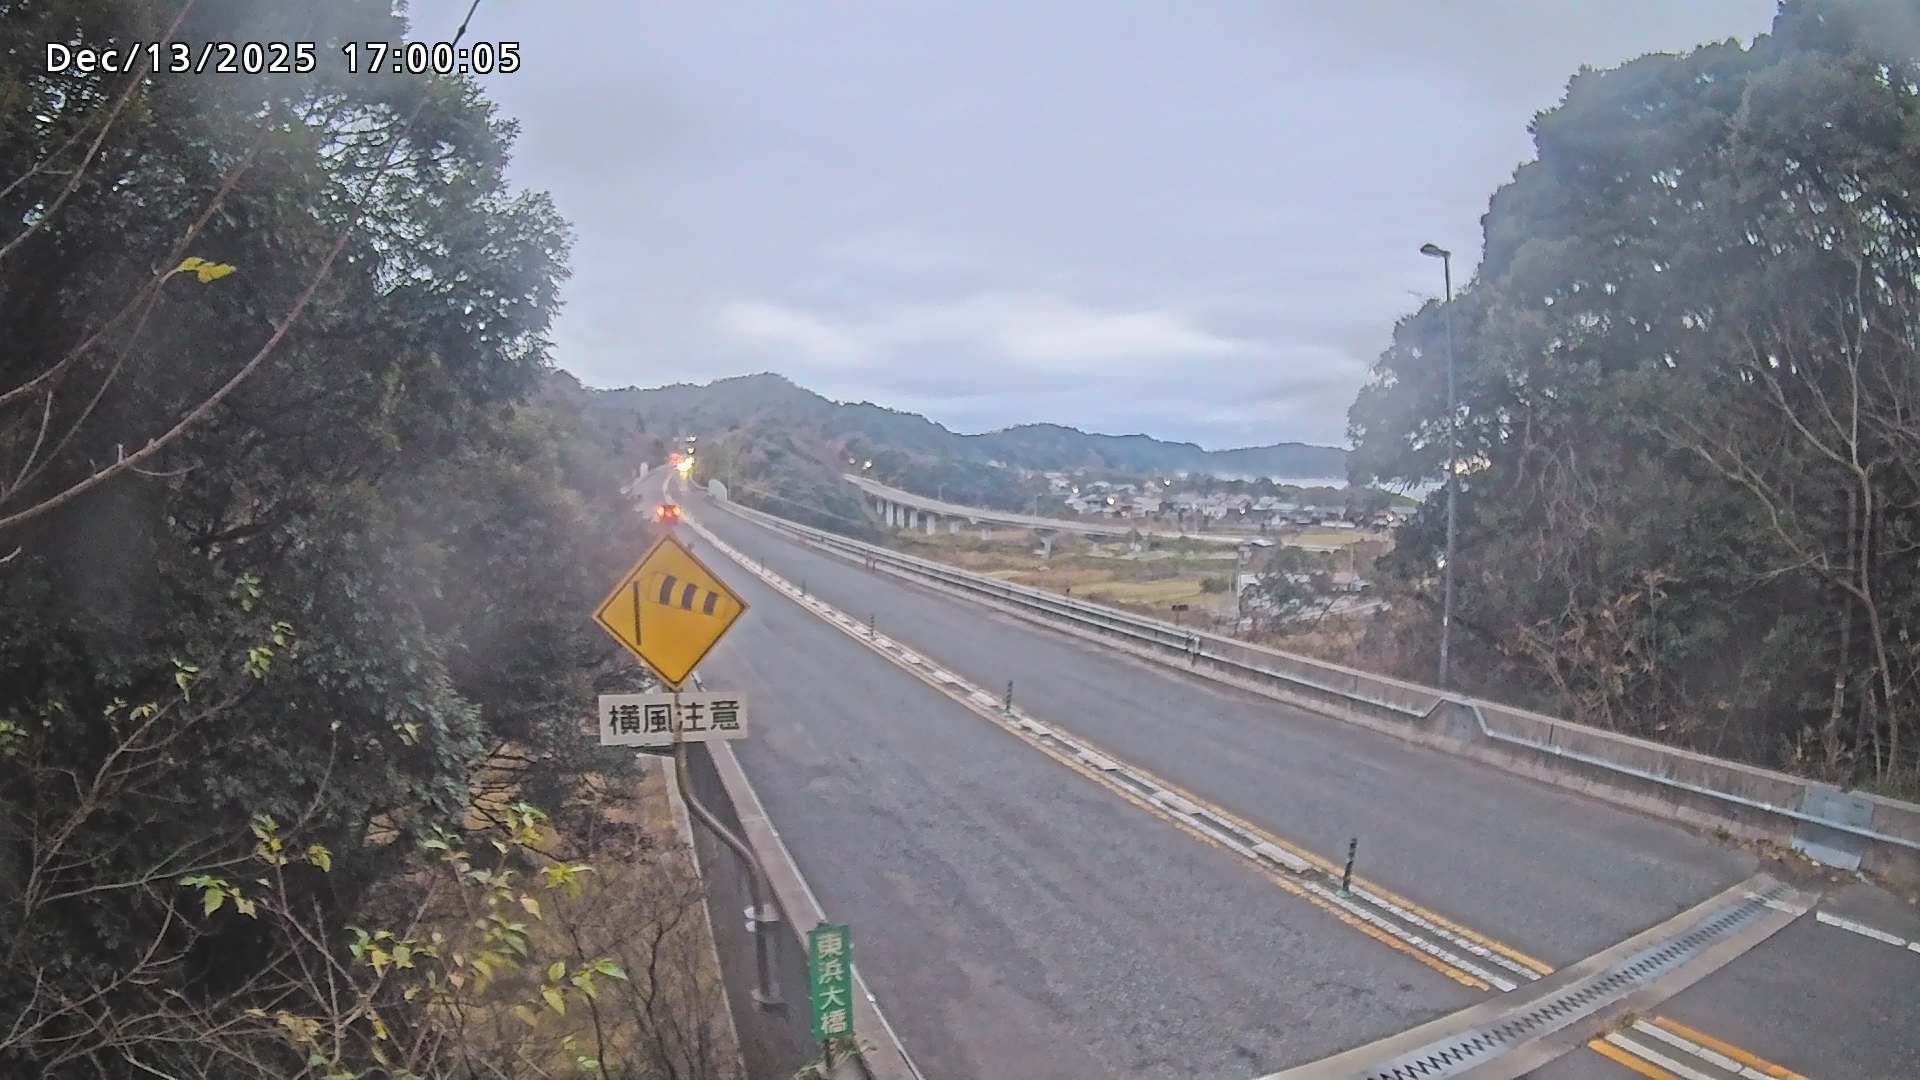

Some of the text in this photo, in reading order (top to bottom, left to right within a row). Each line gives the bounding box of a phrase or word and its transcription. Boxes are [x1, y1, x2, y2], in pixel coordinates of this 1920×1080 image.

[608, 700, 741, 736] 横風注意
[815, 931, 848, 1036] 東浜大橋
